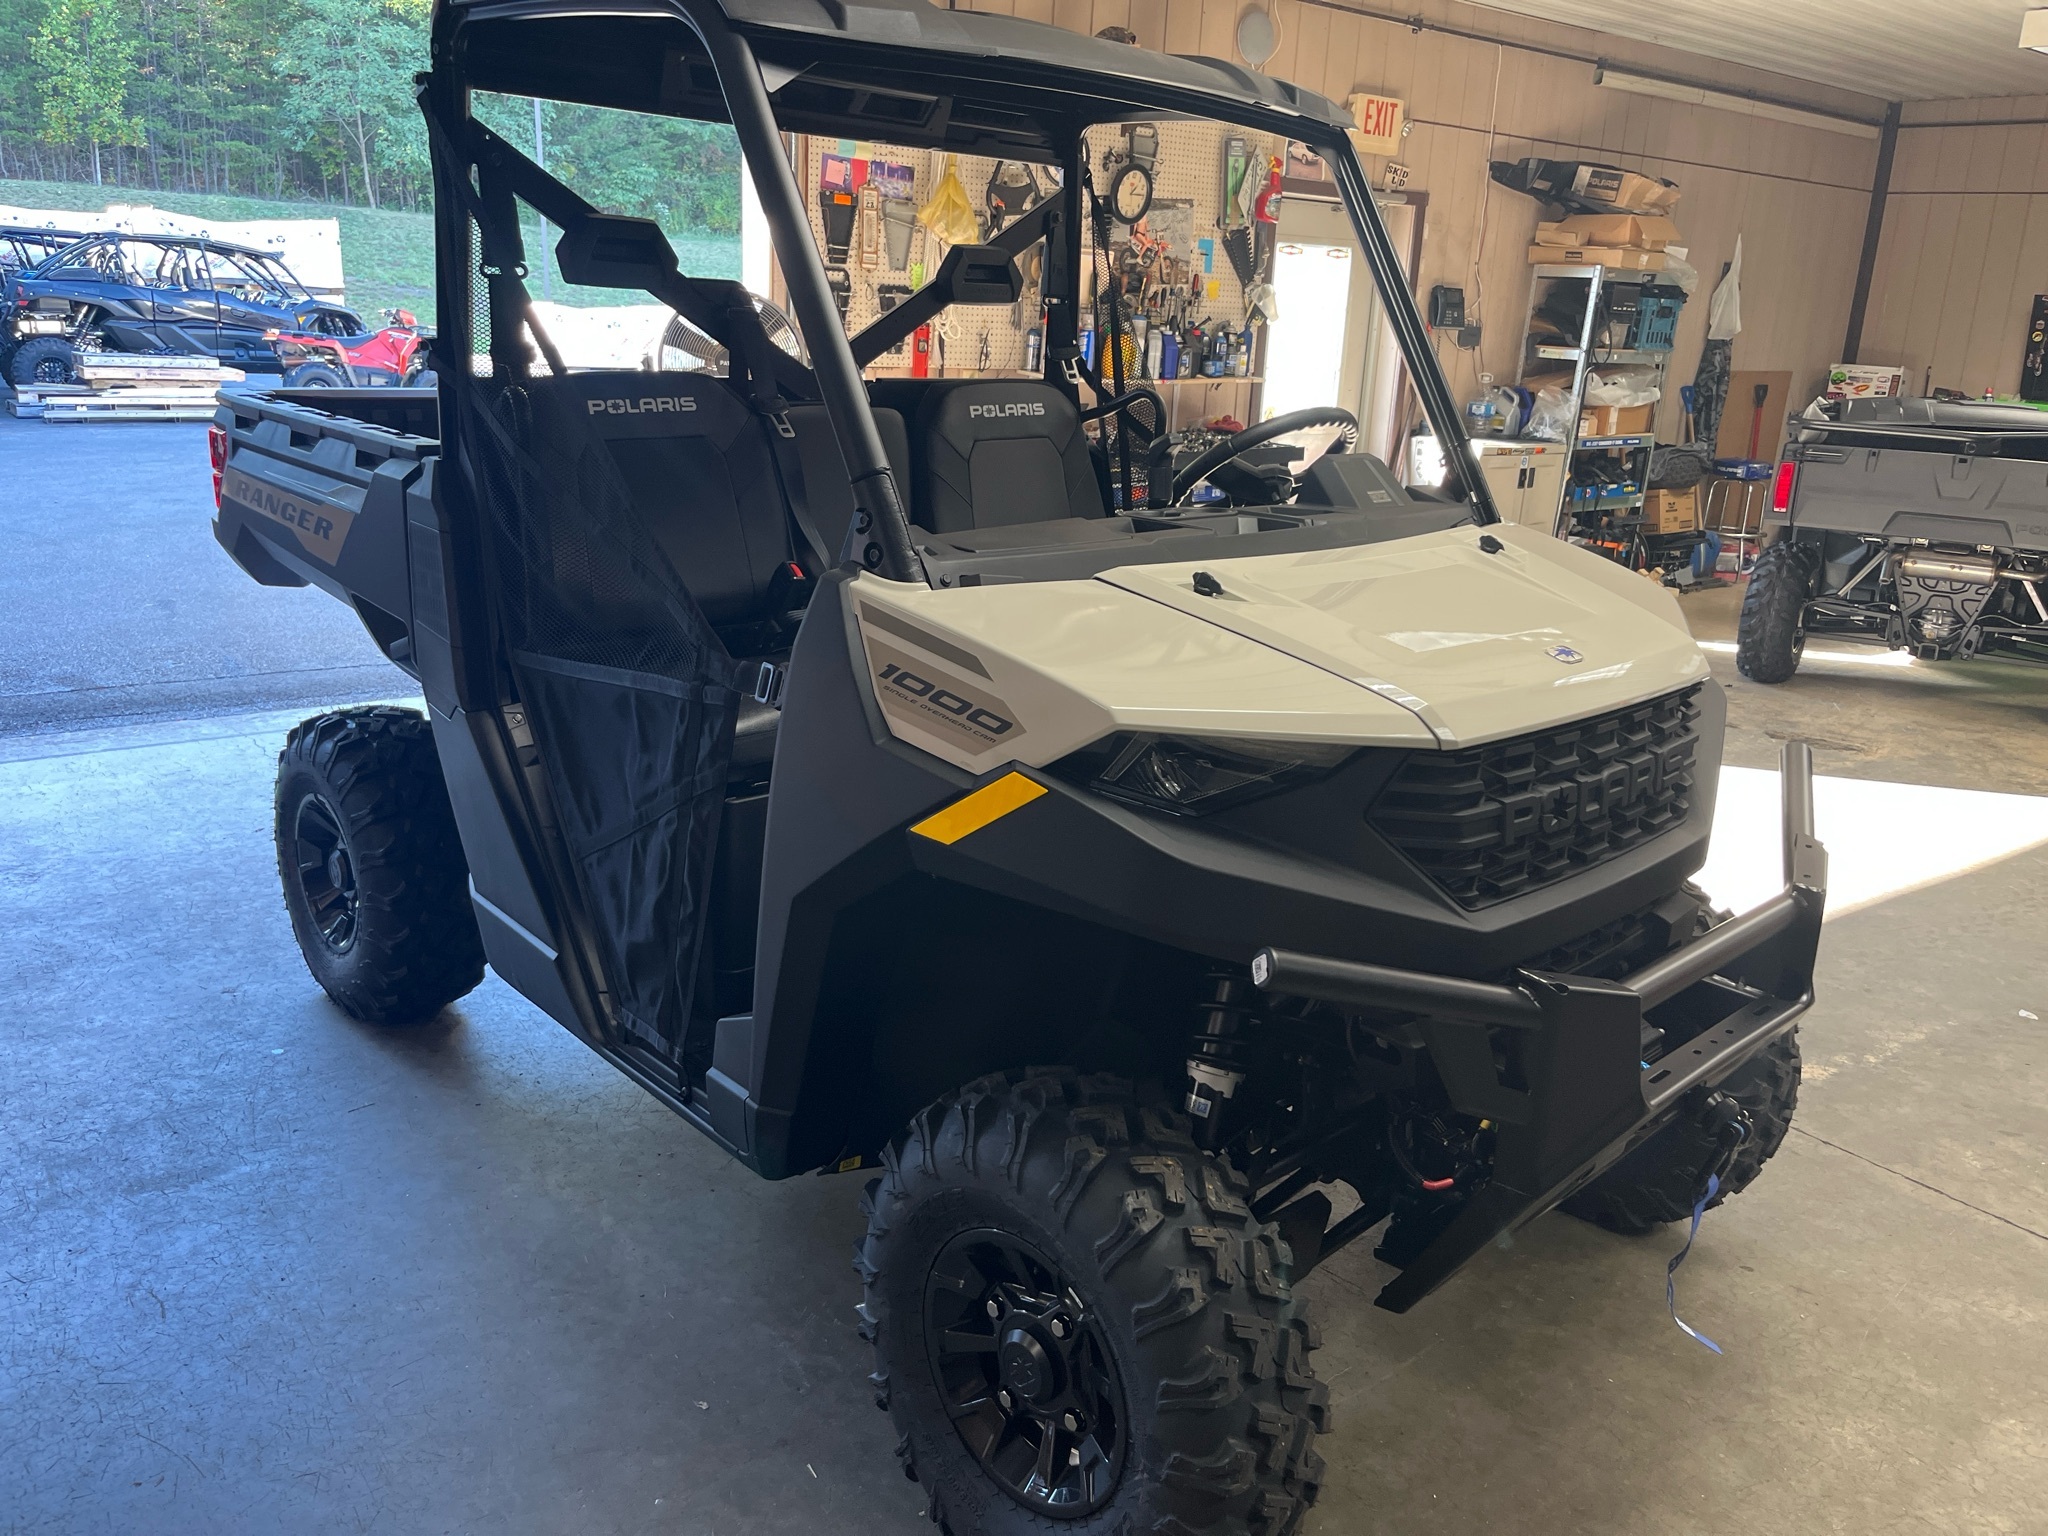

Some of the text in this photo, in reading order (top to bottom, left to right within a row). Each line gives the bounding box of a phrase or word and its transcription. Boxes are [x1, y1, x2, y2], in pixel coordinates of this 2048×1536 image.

[1363, 98, 1398, 138] EXIT
[1387, 165, 1409, 179] SKID
[587, 396, 698, 415] POLARIS
[969, 402, 1046, 419] POLARIS
[235, 480, 334, 541] RANGER
[878, 663, 1014, 735] 1000
[882, 684, 919, 705] SINGLE
[919, 703, 973, 731] OVERHEAD
[1503, 732, 1700, 846] POLARIS
